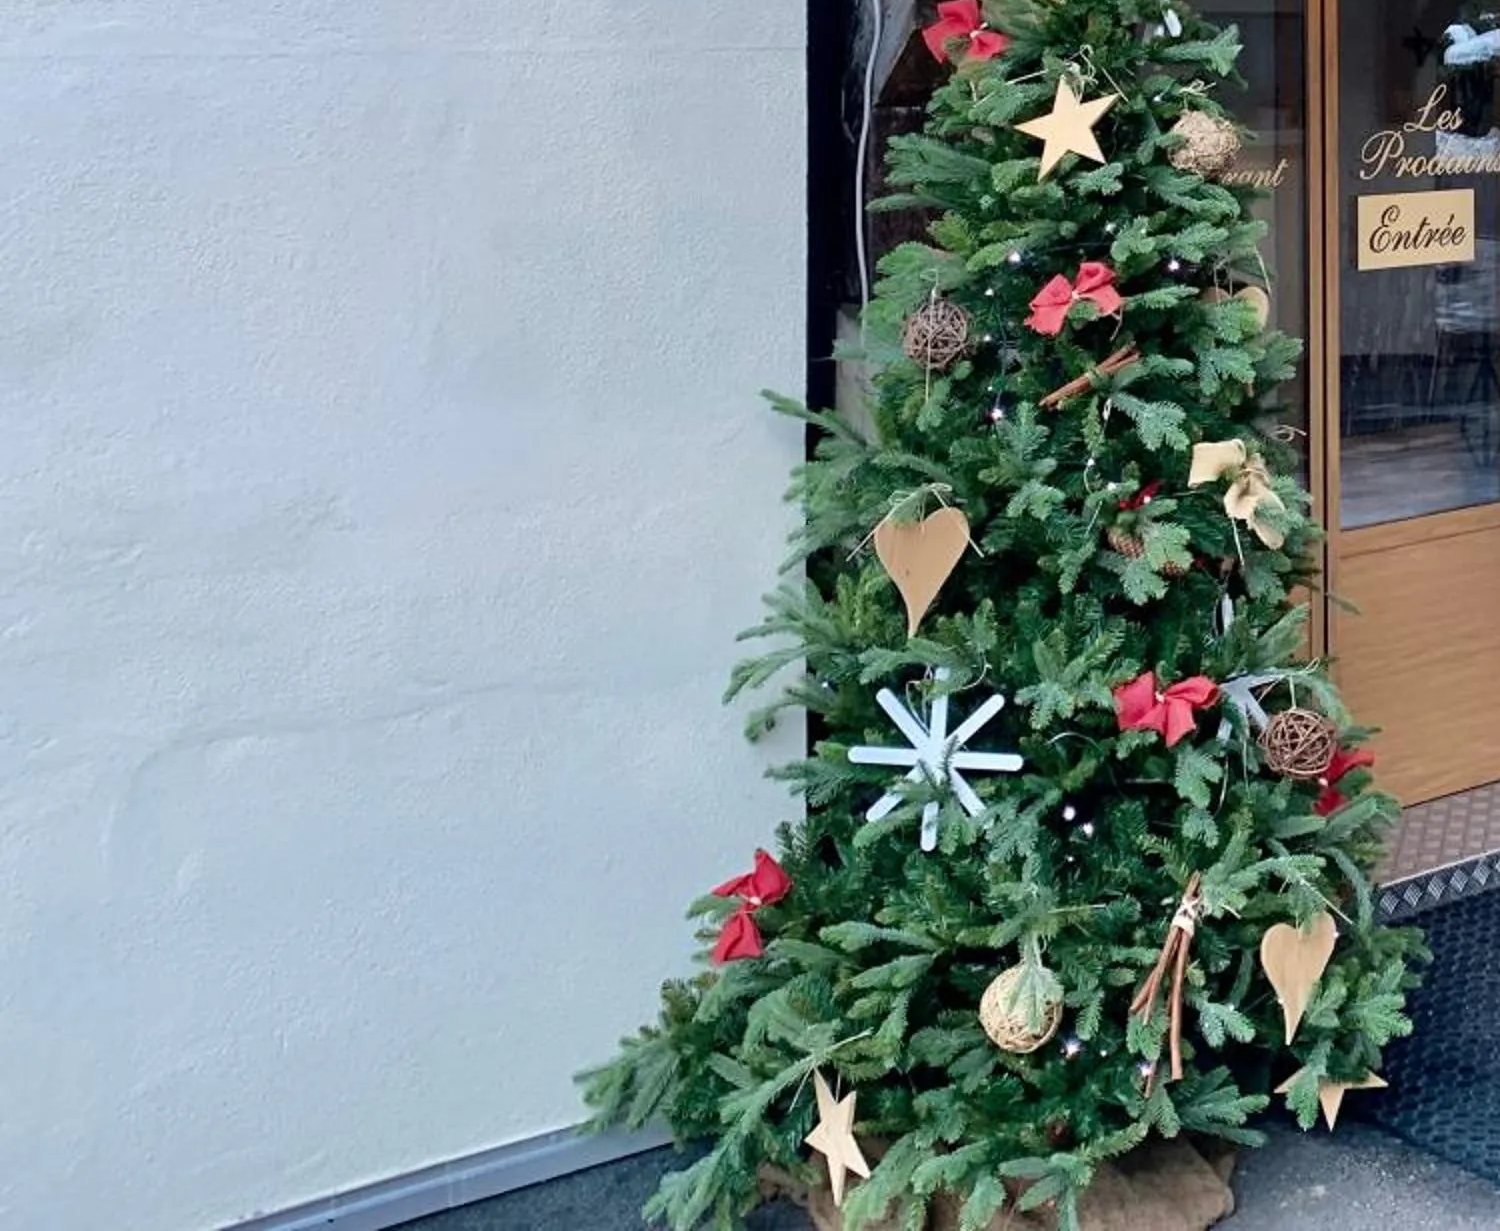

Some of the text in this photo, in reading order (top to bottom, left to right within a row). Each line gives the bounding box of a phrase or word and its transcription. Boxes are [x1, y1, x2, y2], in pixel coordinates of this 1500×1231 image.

[1403, 83, 1464, 132] Les
[1221, 158, 1289, 189] rant
[1369, 204, 1467, 254] Entrée
